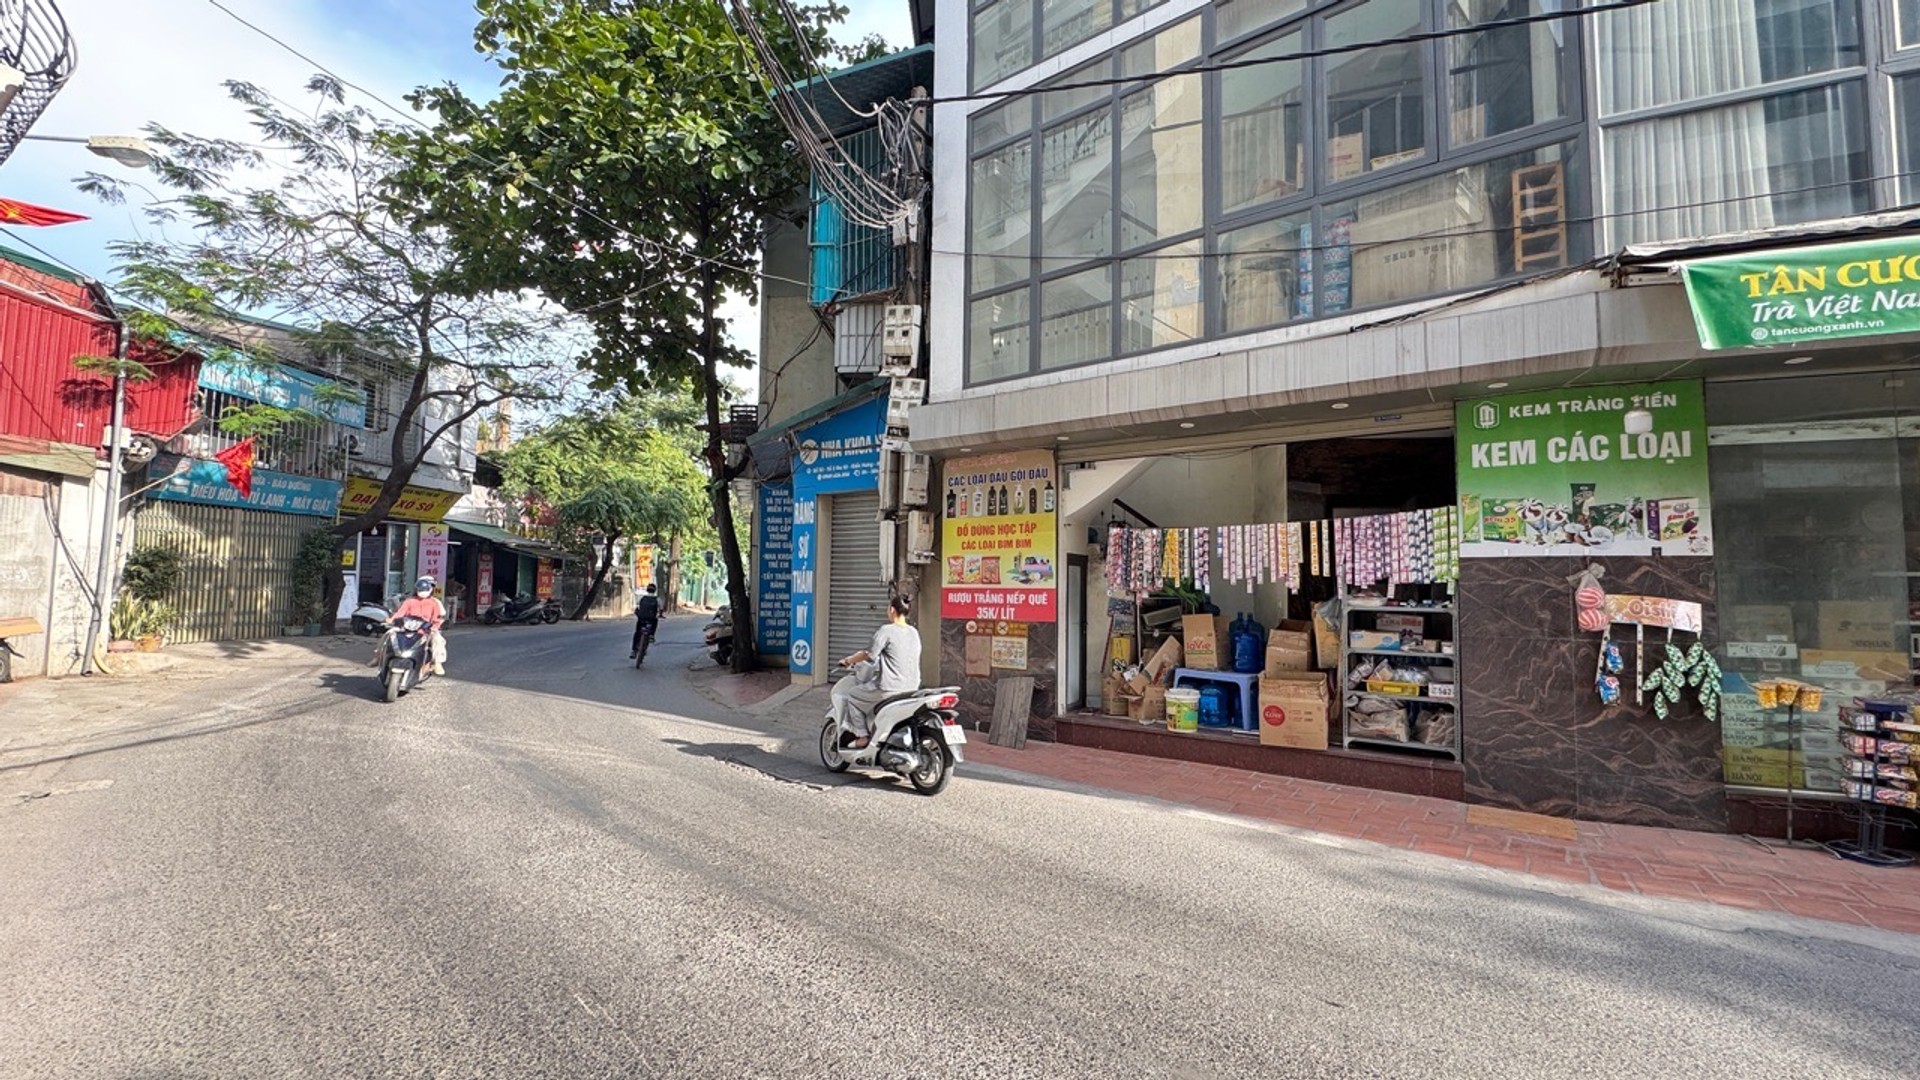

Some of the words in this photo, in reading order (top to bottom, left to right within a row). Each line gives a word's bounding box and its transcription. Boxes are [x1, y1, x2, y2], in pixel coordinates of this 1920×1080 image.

[1740, 264, 1827, 298] TÂN
[1751, 300, 1796, 323] Trà
[1805, 295, 1861, 320] Việt
[1871, 289, 1920, 312] Na
[1771, 319, 1885, 338] tancuongxanh.vn
[1509, 403, 1551, 418] KEM
[1557, 395, 1625, 413] TRÀNG
[1630, 391, 1677, 408] TIỀN
[821, 440, 842, 458] NHA
[845, 435, 873, 456] KHOA
[1471, 438, 1537, 468] KEM
[1547, 430, 1610, 463] CÁC
[1619, 430, 1692, 464] LOẠI
[794, 497, 814, 525] RĂNG
[998, 524, 1017, 537] HỌC
[1019, 521, 1037, 536] TẬP
[998, 539, 1013, 549] BIM
[1016, 538, 1031, 549] BIM
[948, 592, 972, 605] RƯỢU
[974, 590, 1005, 604] TRẮNG
[1007, 590, 1026, 604] NẾP
[977, 606, 999, 619] 35K/
[1001, 604, 1015, 619] LÍT
[795, 644, 808, 660] 22
